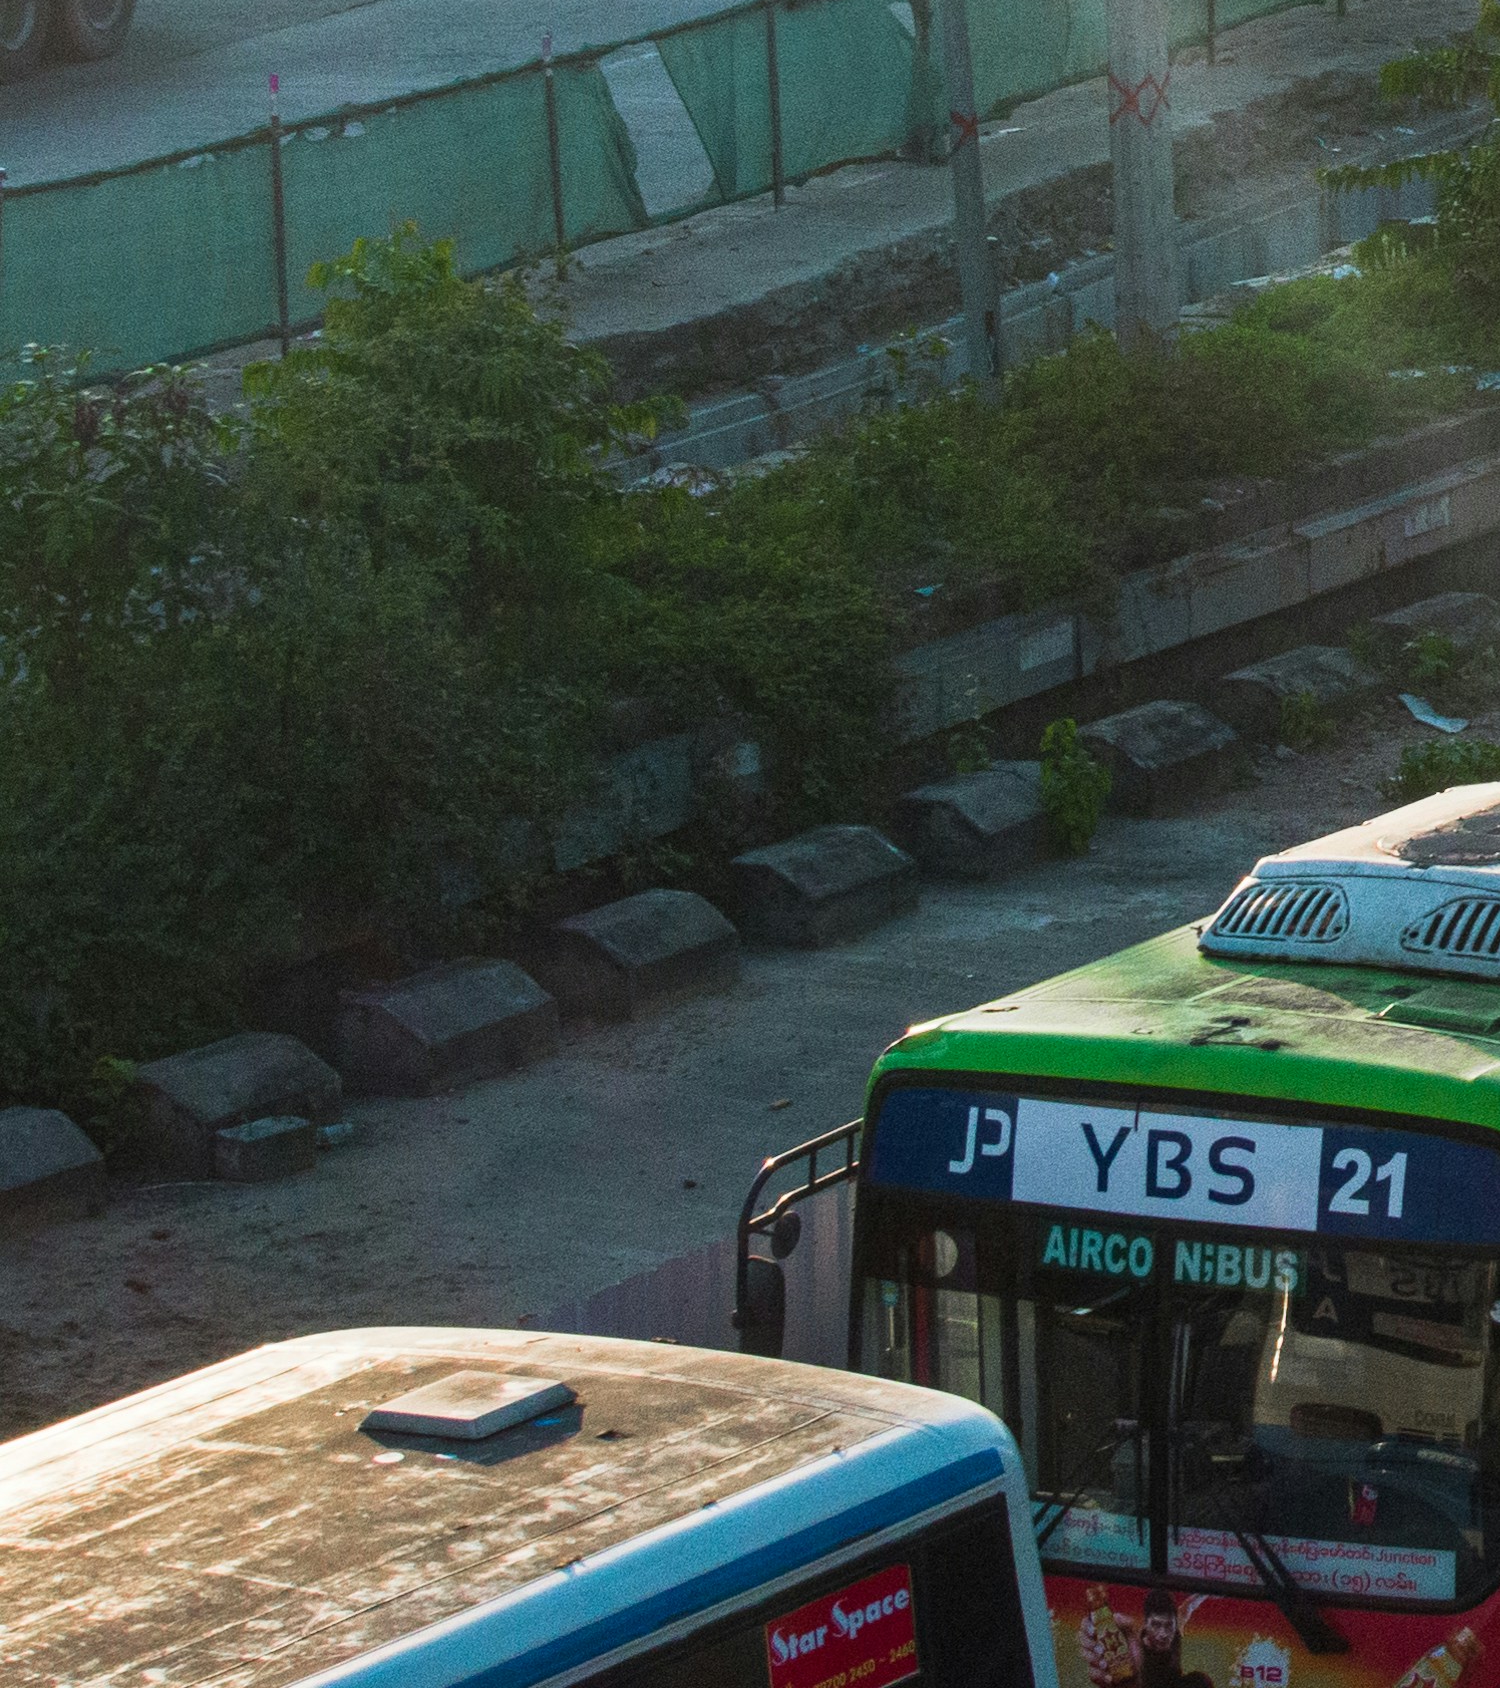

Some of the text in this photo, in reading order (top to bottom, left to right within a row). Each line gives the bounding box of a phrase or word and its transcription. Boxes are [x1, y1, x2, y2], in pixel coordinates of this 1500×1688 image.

[1082, 1120, 1258, 1206] YBS
[1327, 1146, 1409, 1219] 21
[1043, 1225, 1155, 1279] AIRCO
[1376, 1549, 1437, 1567] Junction
[772, 1587, 910, 1667] Star Space
[1240, 1664, 1284, 1684] B12
